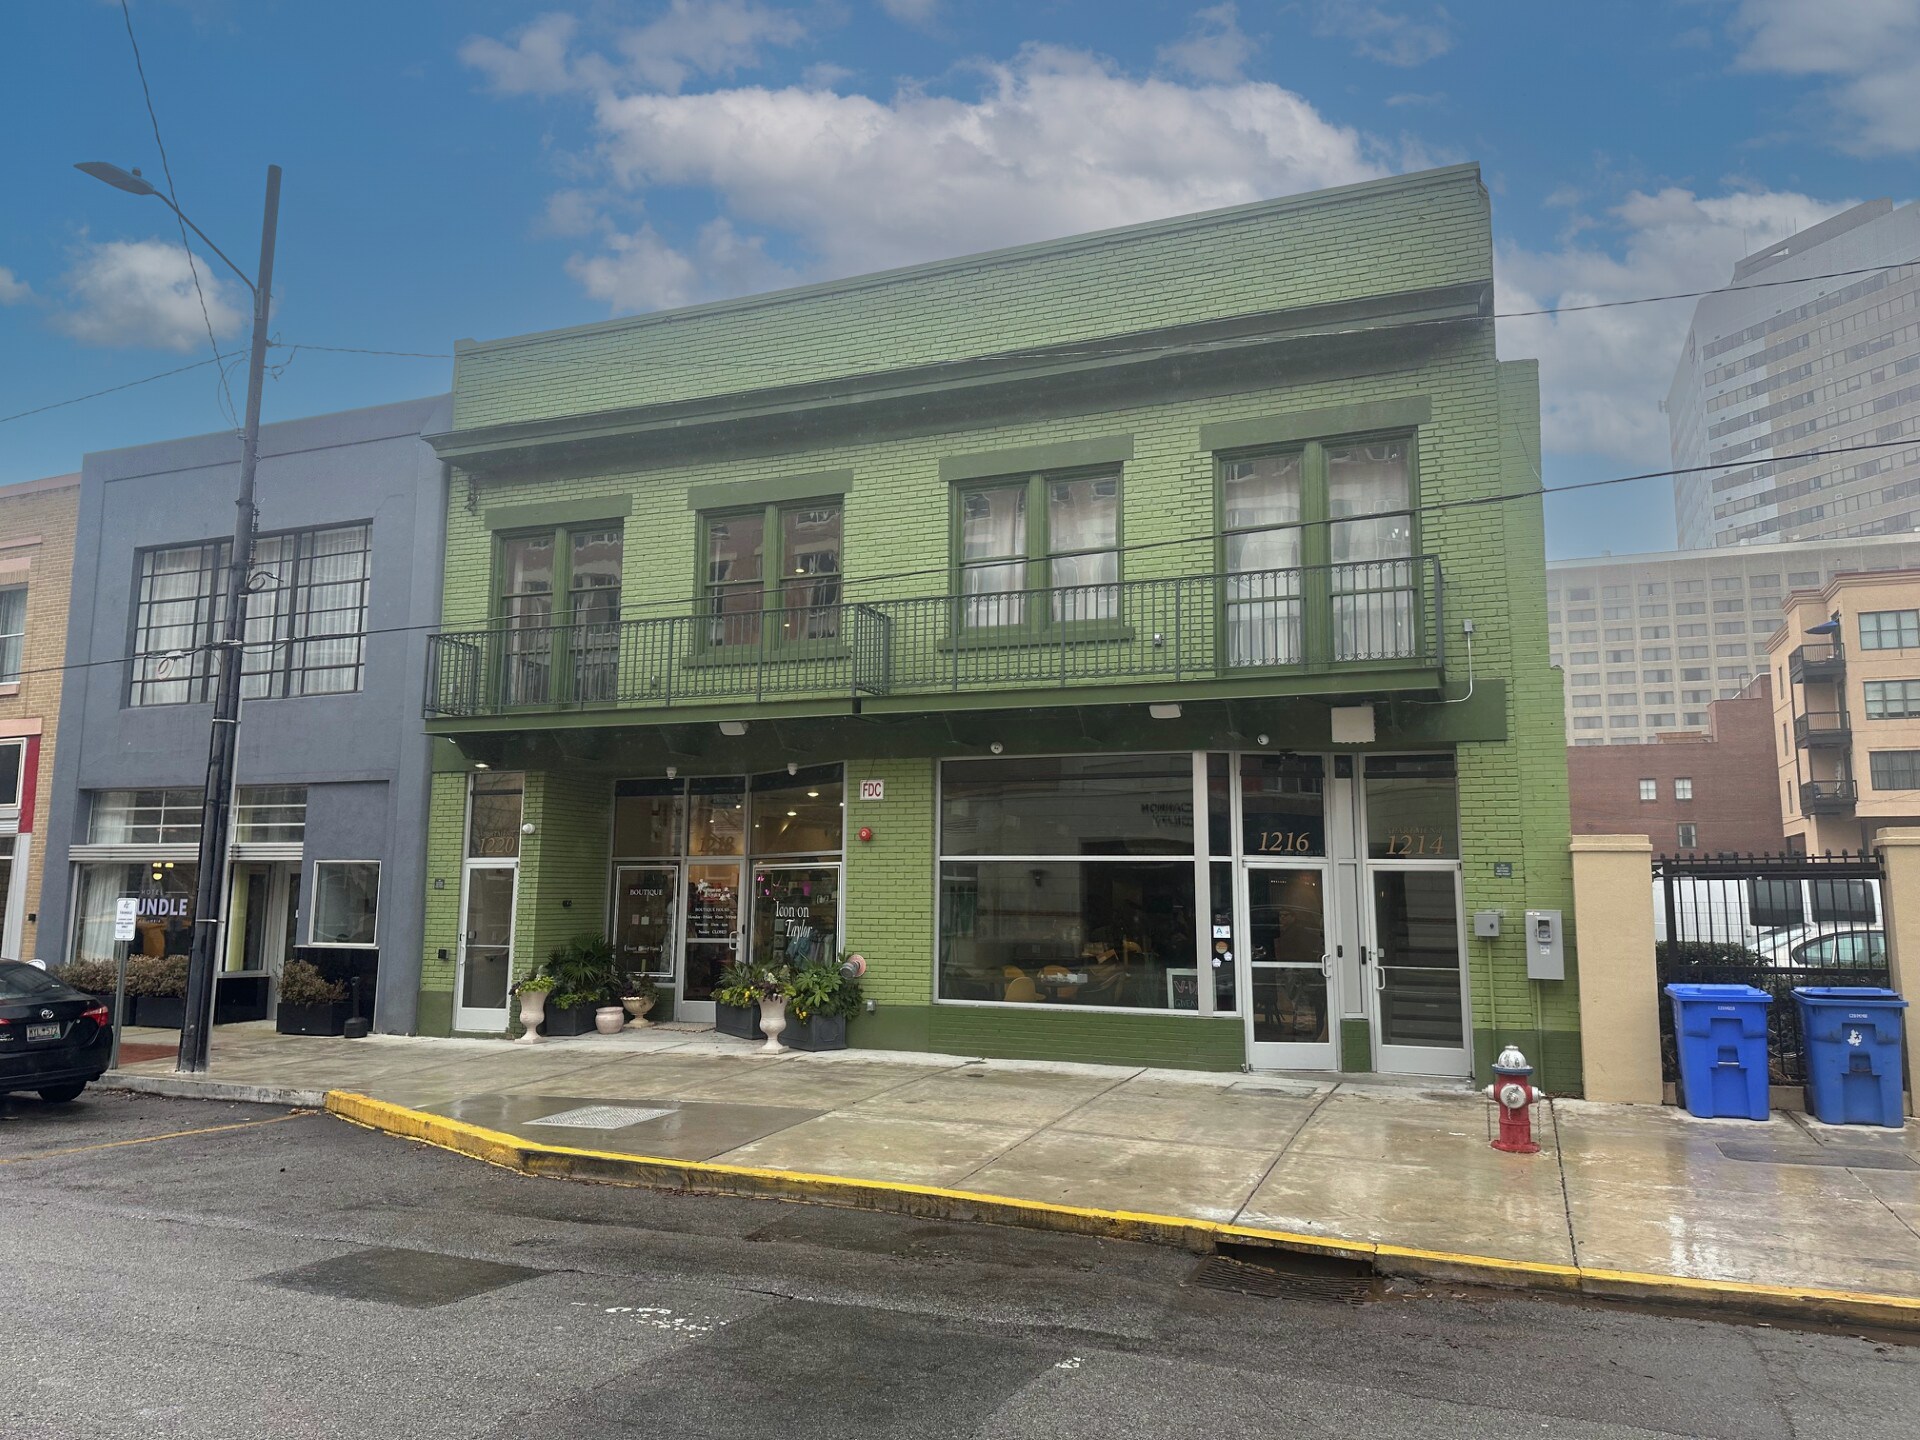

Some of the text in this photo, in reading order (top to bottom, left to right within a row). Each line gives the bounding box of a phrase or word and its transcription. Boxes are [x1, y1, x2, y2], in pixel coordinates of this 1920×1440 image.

[862, 782, 881, 797] FDC
[480, 836, 515, 853] 1220
[1258, 831, 1310, 851] 1216
[1385, 835, 1444, 855] 1214
[137, 898, 188, 916] UNDLE
[775, 901, 809, 918] Icon on
[785, 919, 813, 944] Taylor
